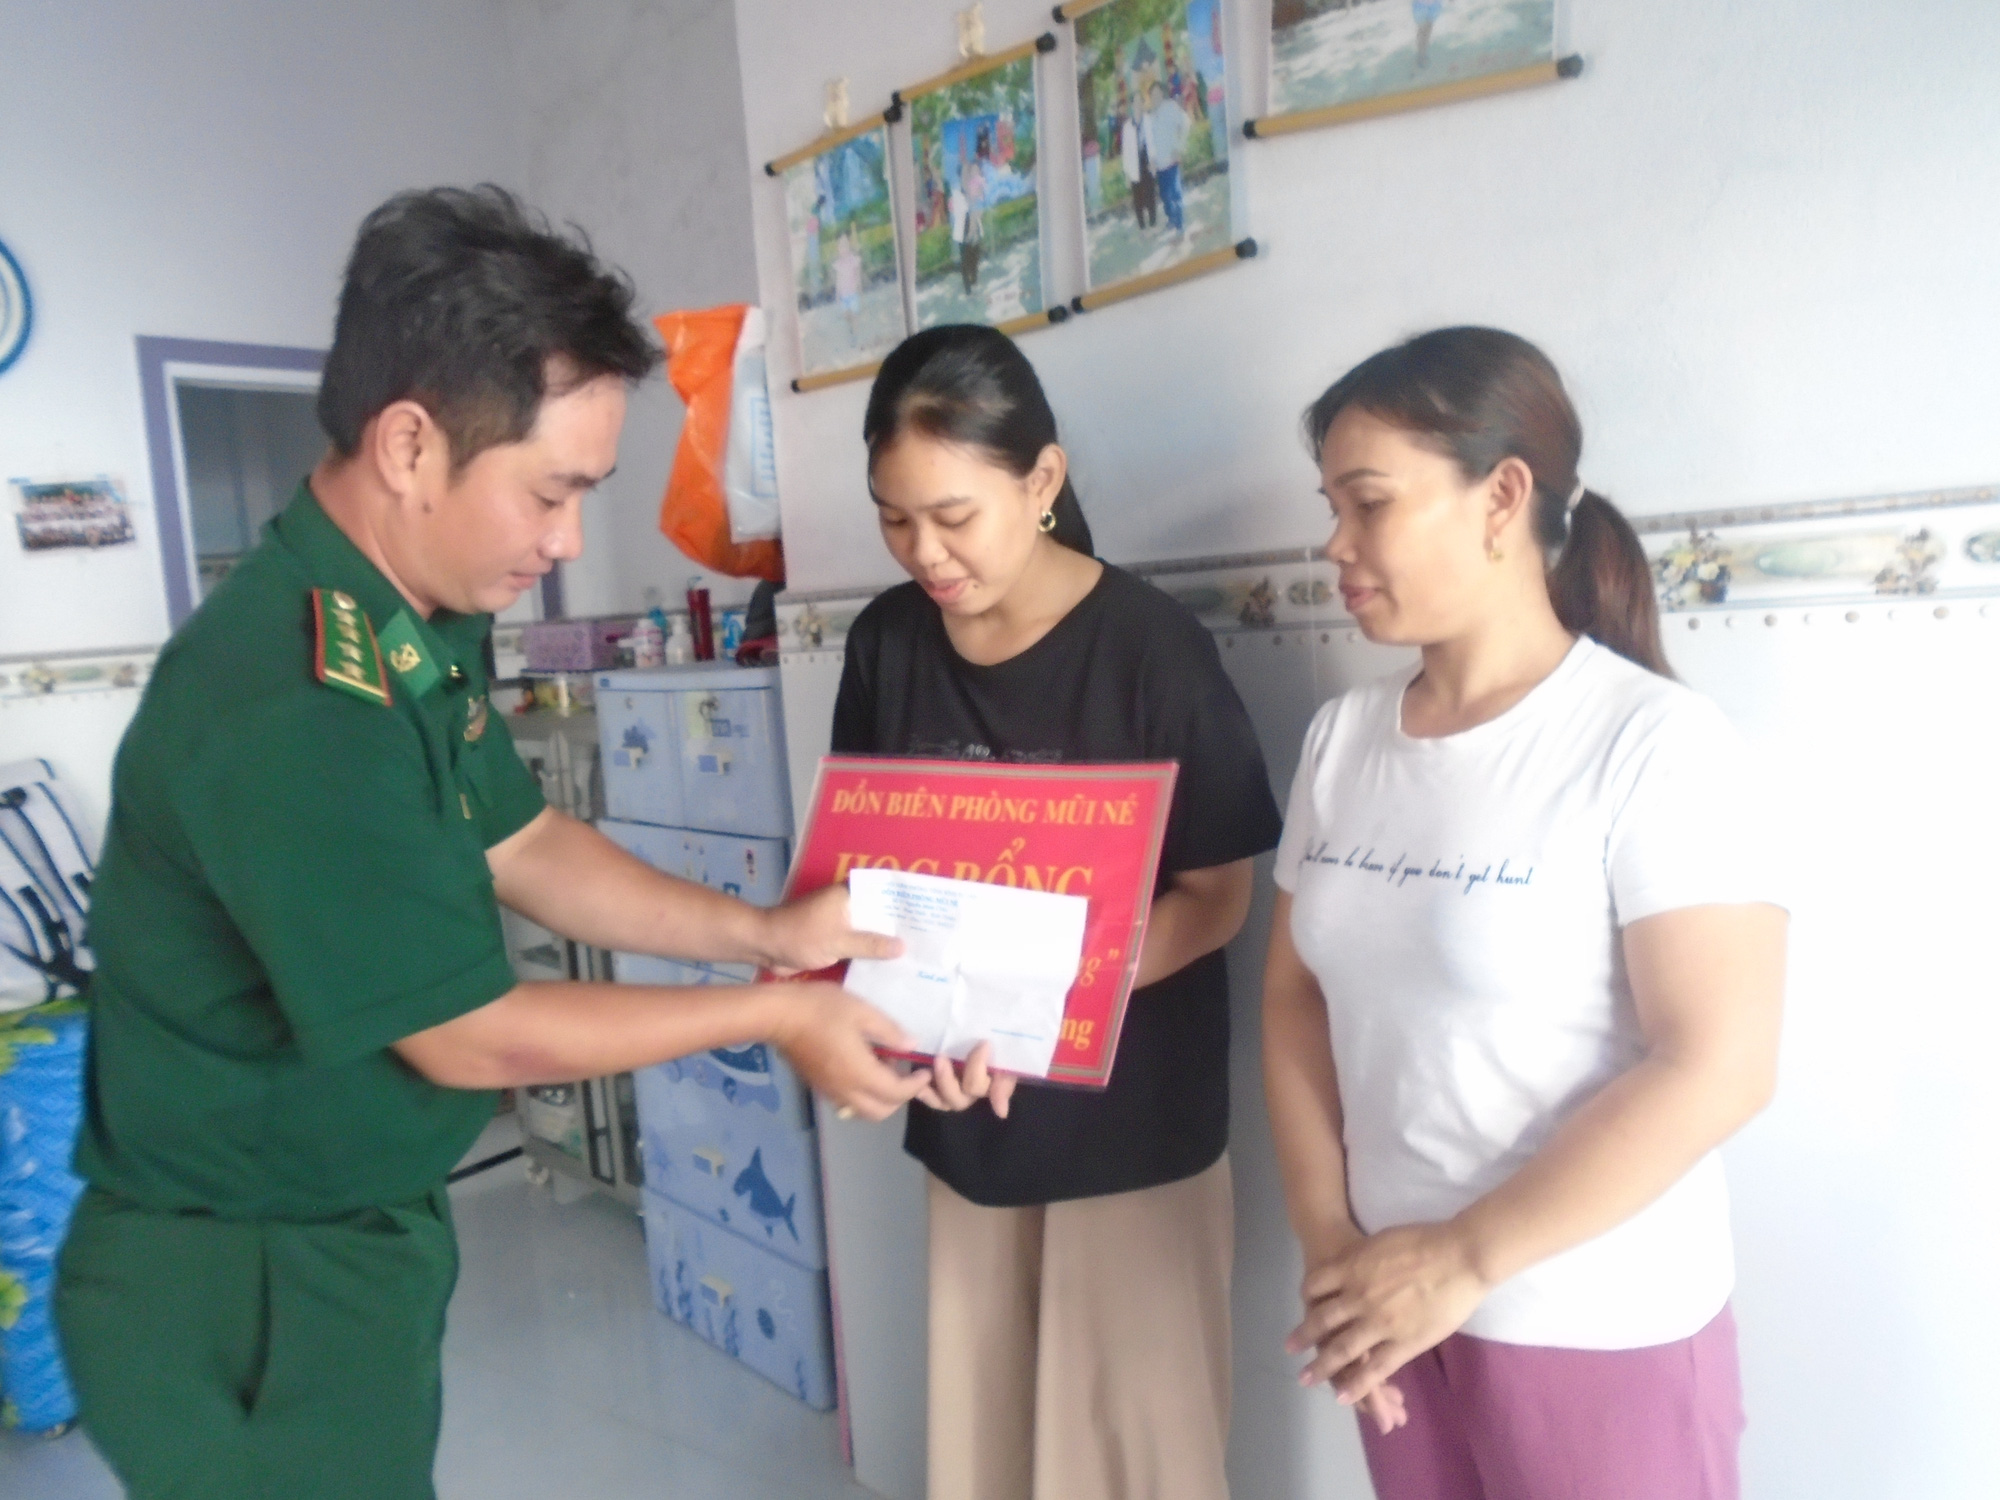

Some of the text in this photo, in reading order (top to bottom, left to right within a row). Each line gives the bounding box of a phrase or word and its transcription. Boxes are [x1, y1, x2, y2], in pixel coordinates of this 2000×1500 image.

[886, 786, 947, 818] BIÊN
[948, 789, 1038, 823] PHÒNG
[1042, 793, 1098, 825] MŨI
